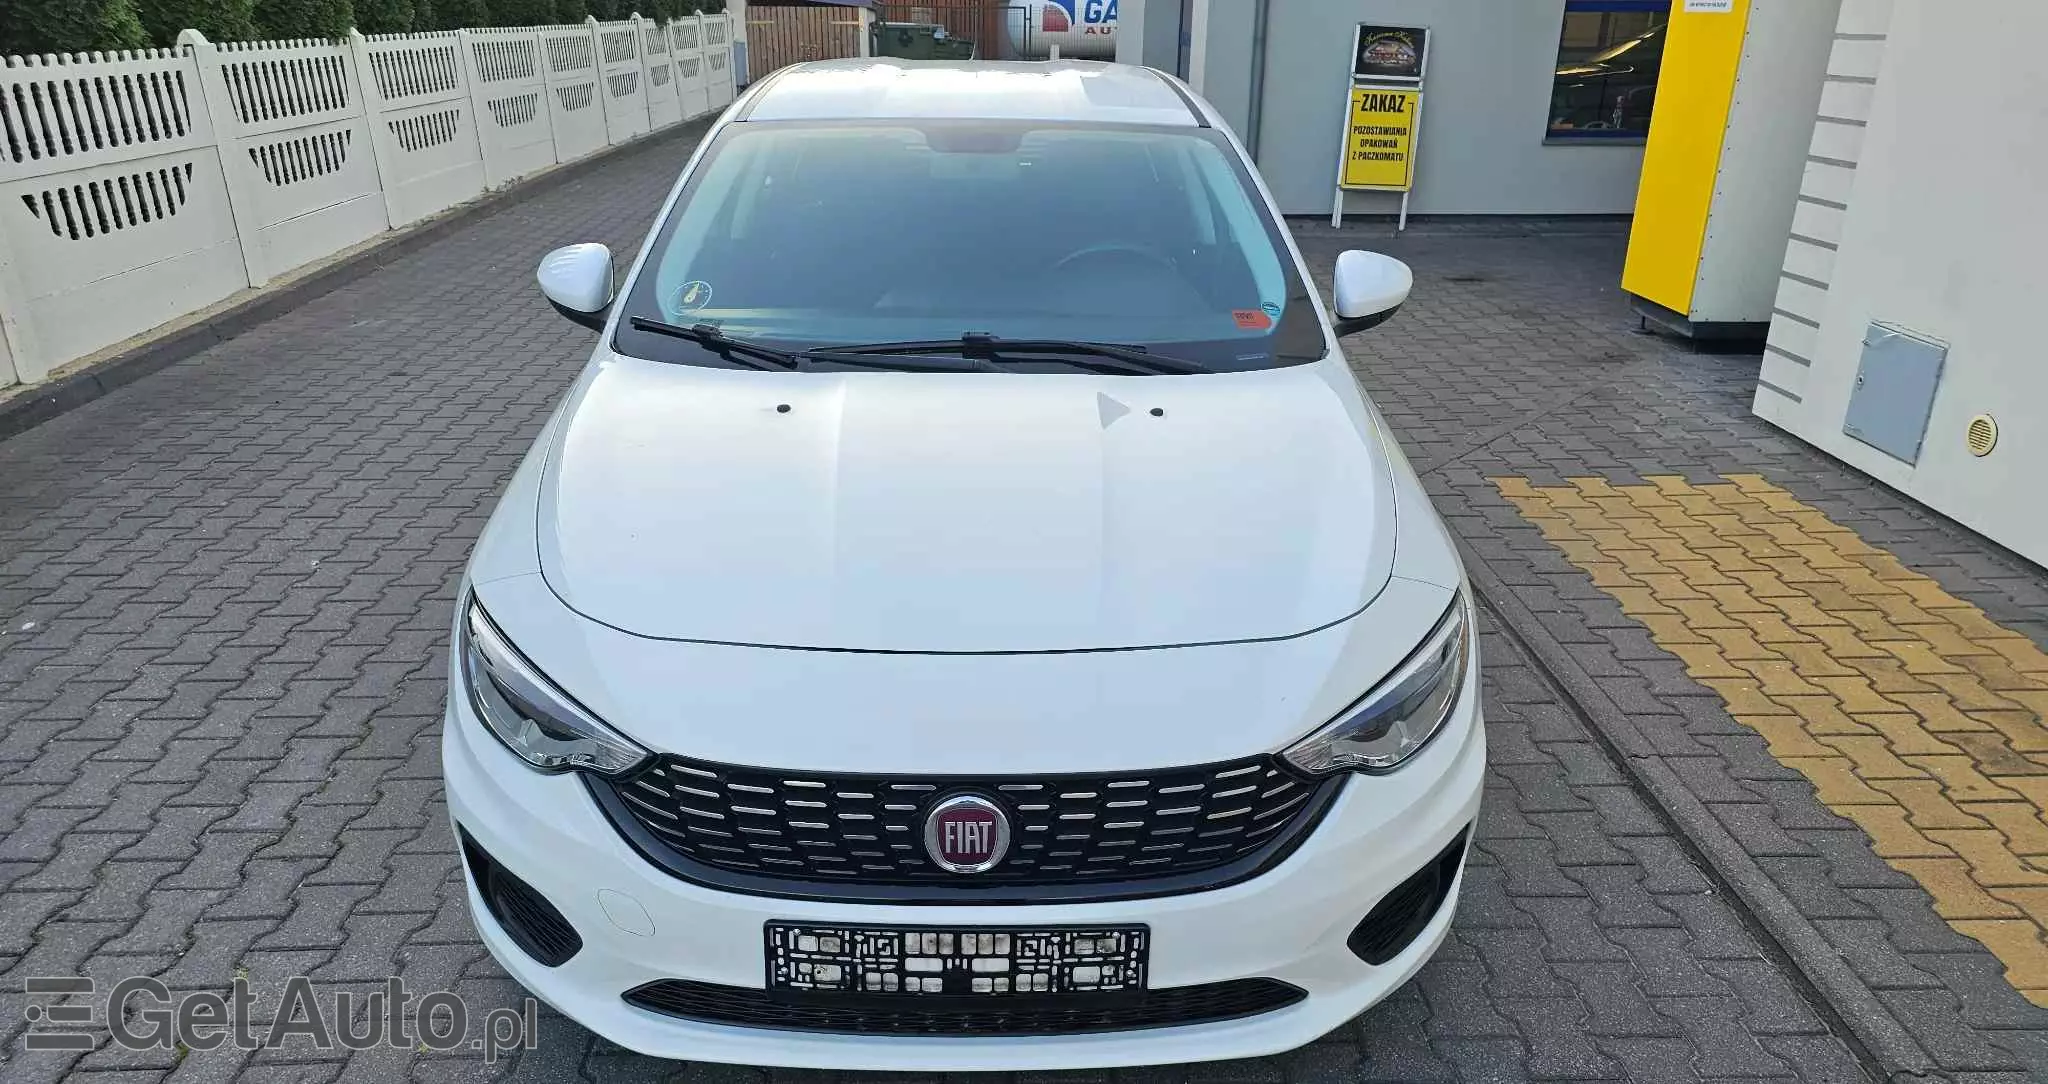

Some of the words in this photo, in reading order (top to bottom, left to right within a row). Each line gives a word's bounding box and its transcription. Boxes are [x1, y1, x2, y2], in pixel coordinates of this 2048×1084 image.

[1361, 94, 1405, 112] ZAKAZ
[1353, 126, 1407, 136] POZOSTAWIANIA
[1360, 138, 1398, 149] OPAKOWAŃ
[1352, 151, 1357, 161] Z
[1358, 151, 1403, 161] PACZKOMATU
[944, 822, 992, 853] FIAT
